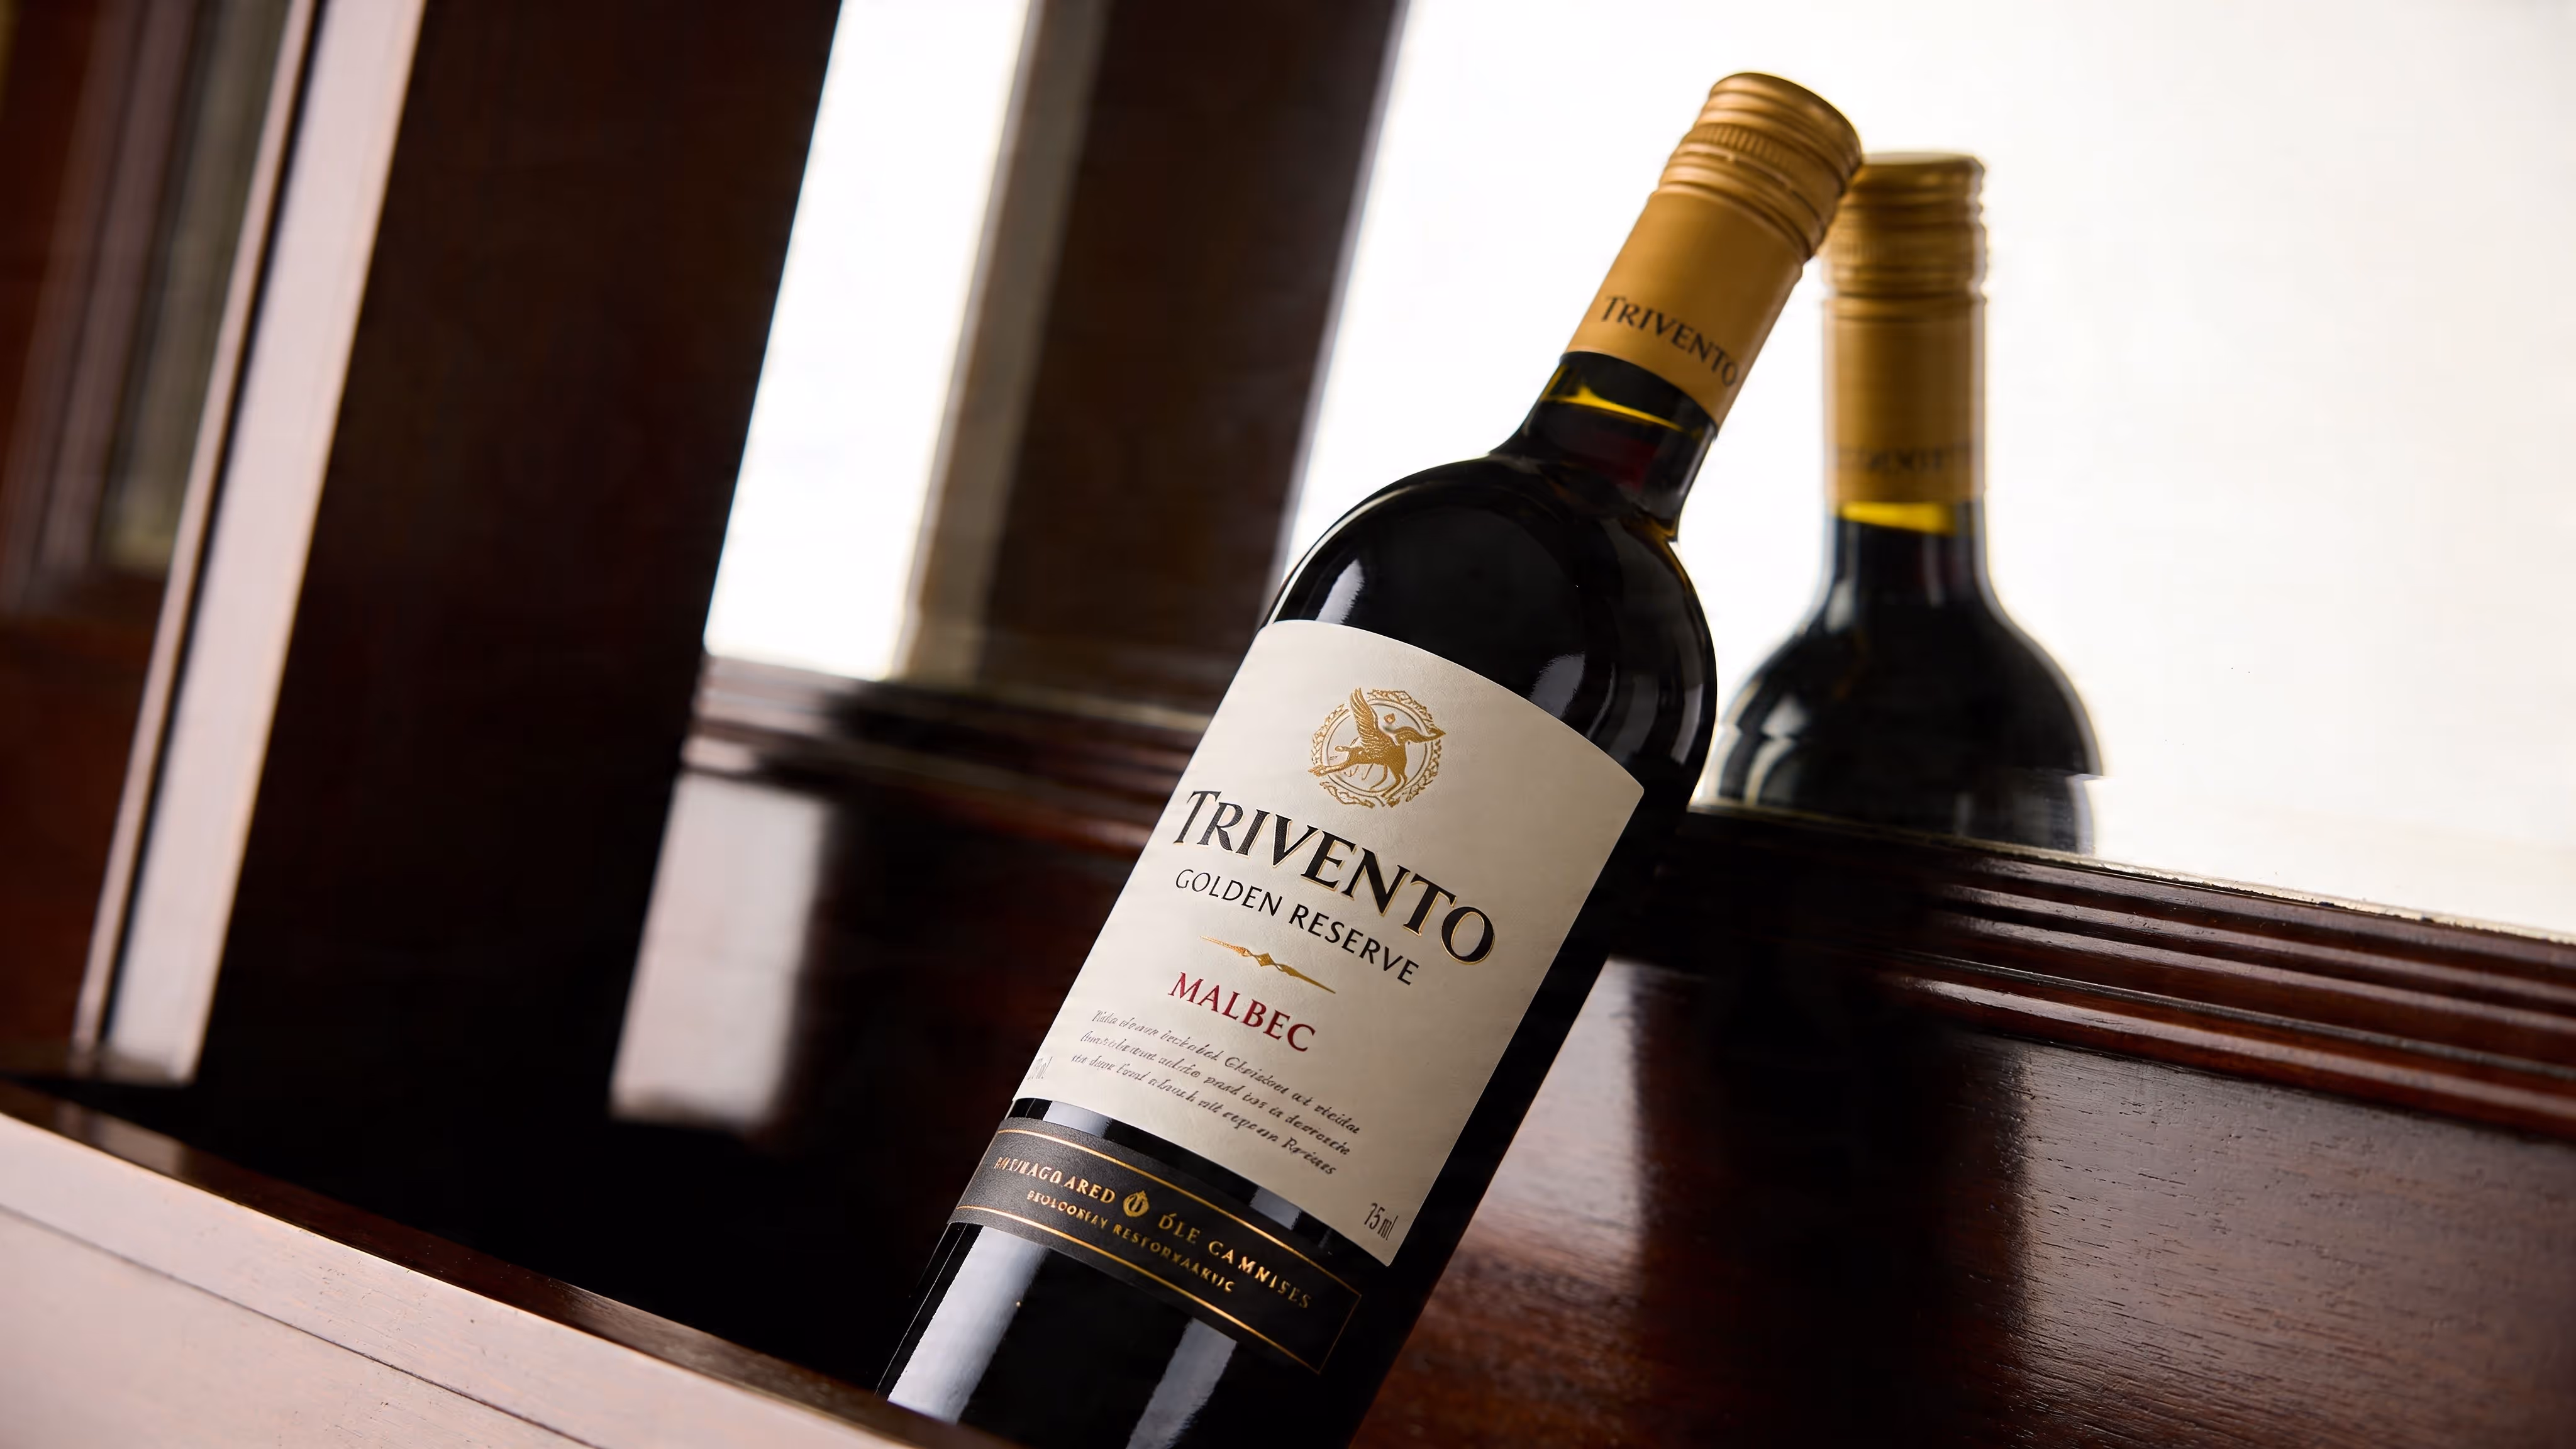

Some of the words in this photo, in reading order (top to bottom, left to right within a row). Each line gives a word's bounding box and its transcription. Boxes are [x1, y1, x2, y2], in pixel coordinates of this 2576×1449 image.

[1601, 296, 1738, 387] TRIVENTO
[1174, 791, 1496, 965] TRIVENTO
[1175, 869, 1283, 916] GOLDEN
[1289, 904, 1420, 985] RESERVE
[1168, 972, 1316, 1052] MALBEC
